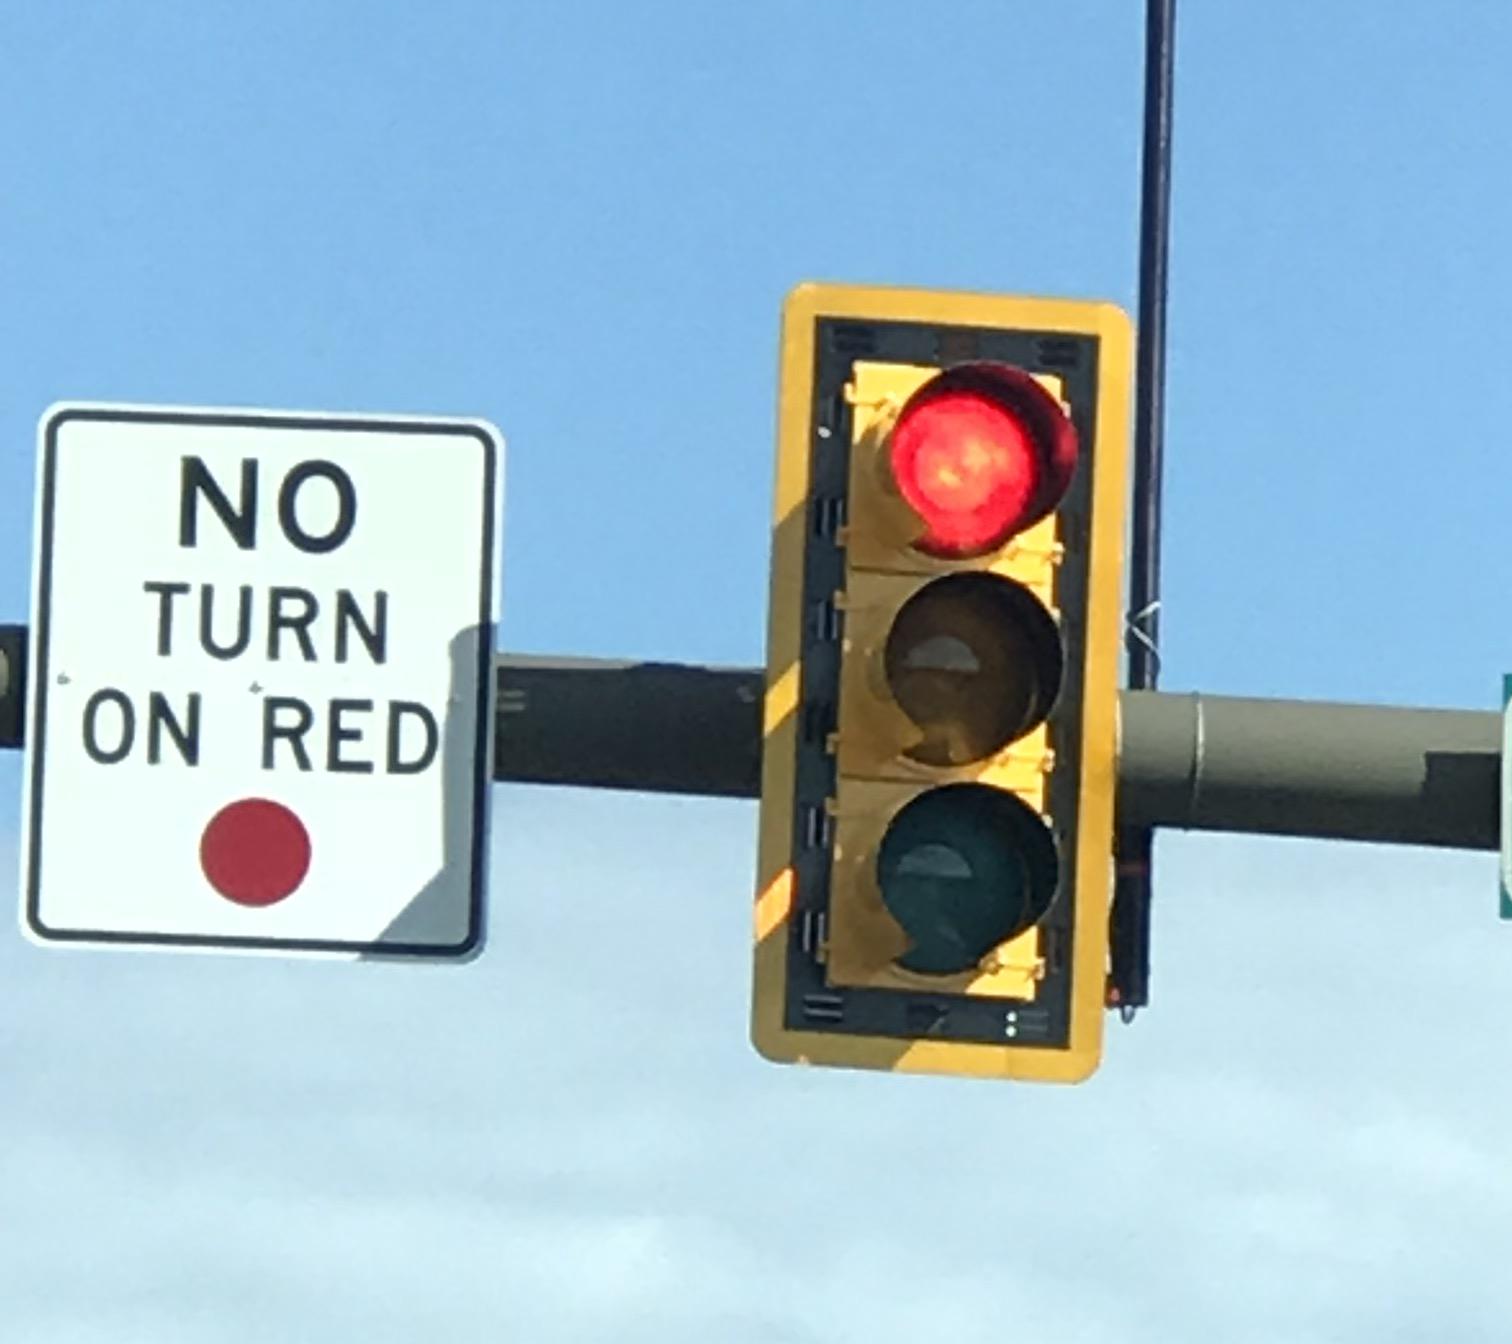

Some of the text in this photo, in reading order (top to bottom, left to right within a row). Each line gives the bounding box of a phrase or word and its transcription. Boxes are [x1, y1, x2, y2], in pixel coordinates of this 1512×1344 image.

[180, 455, 357, 555] NO
[142, 580, 389, 665] TURN
[82, 686, 440, 776] ON RED
